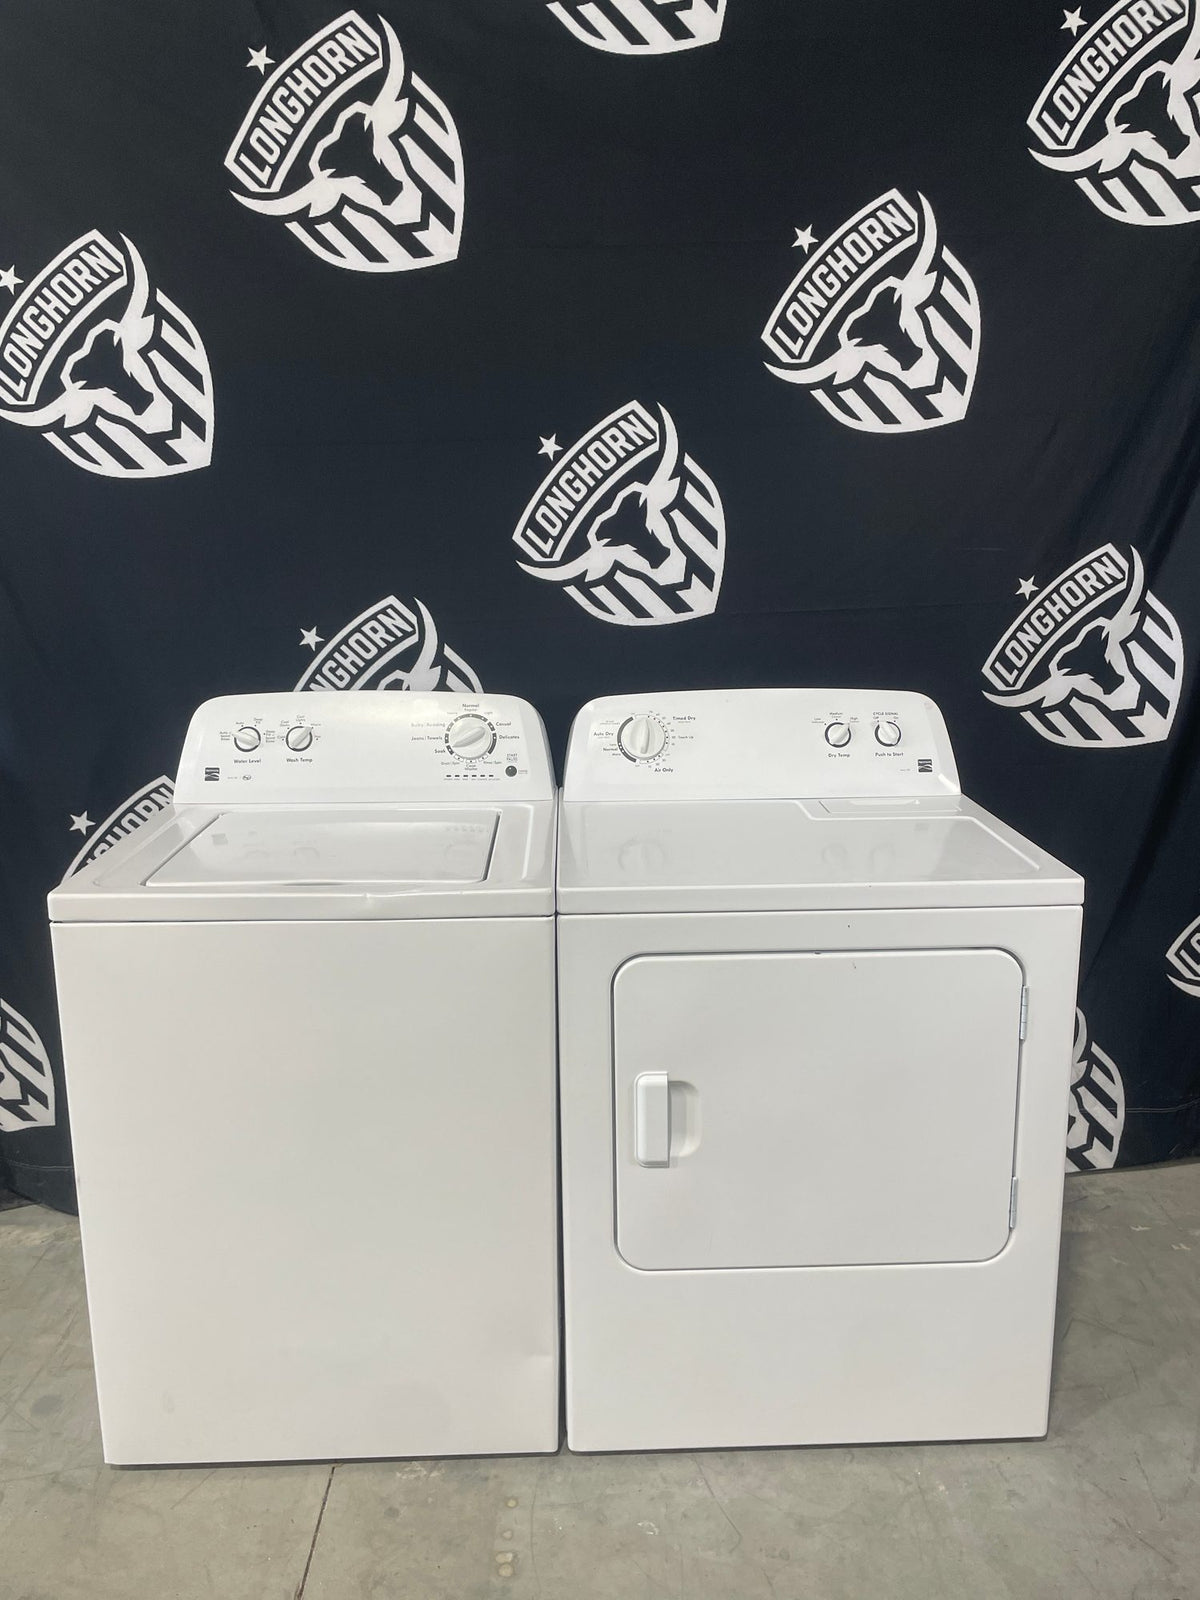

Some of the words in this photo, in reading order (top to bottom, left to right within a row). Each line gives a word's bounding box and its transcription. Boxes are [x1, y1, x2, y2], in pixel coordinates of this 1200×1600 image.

[239, 26, 377, 185] LONGHORN
[1041, 0, 1184, 142] LONGHORN
[0, 245, 122, 398] LONGHORN
[775, 204, 913, 356] LONGHORN
[526, 414, 654, 555] LONGHORN
[995, 556, 1123, 684] LONGHORN
